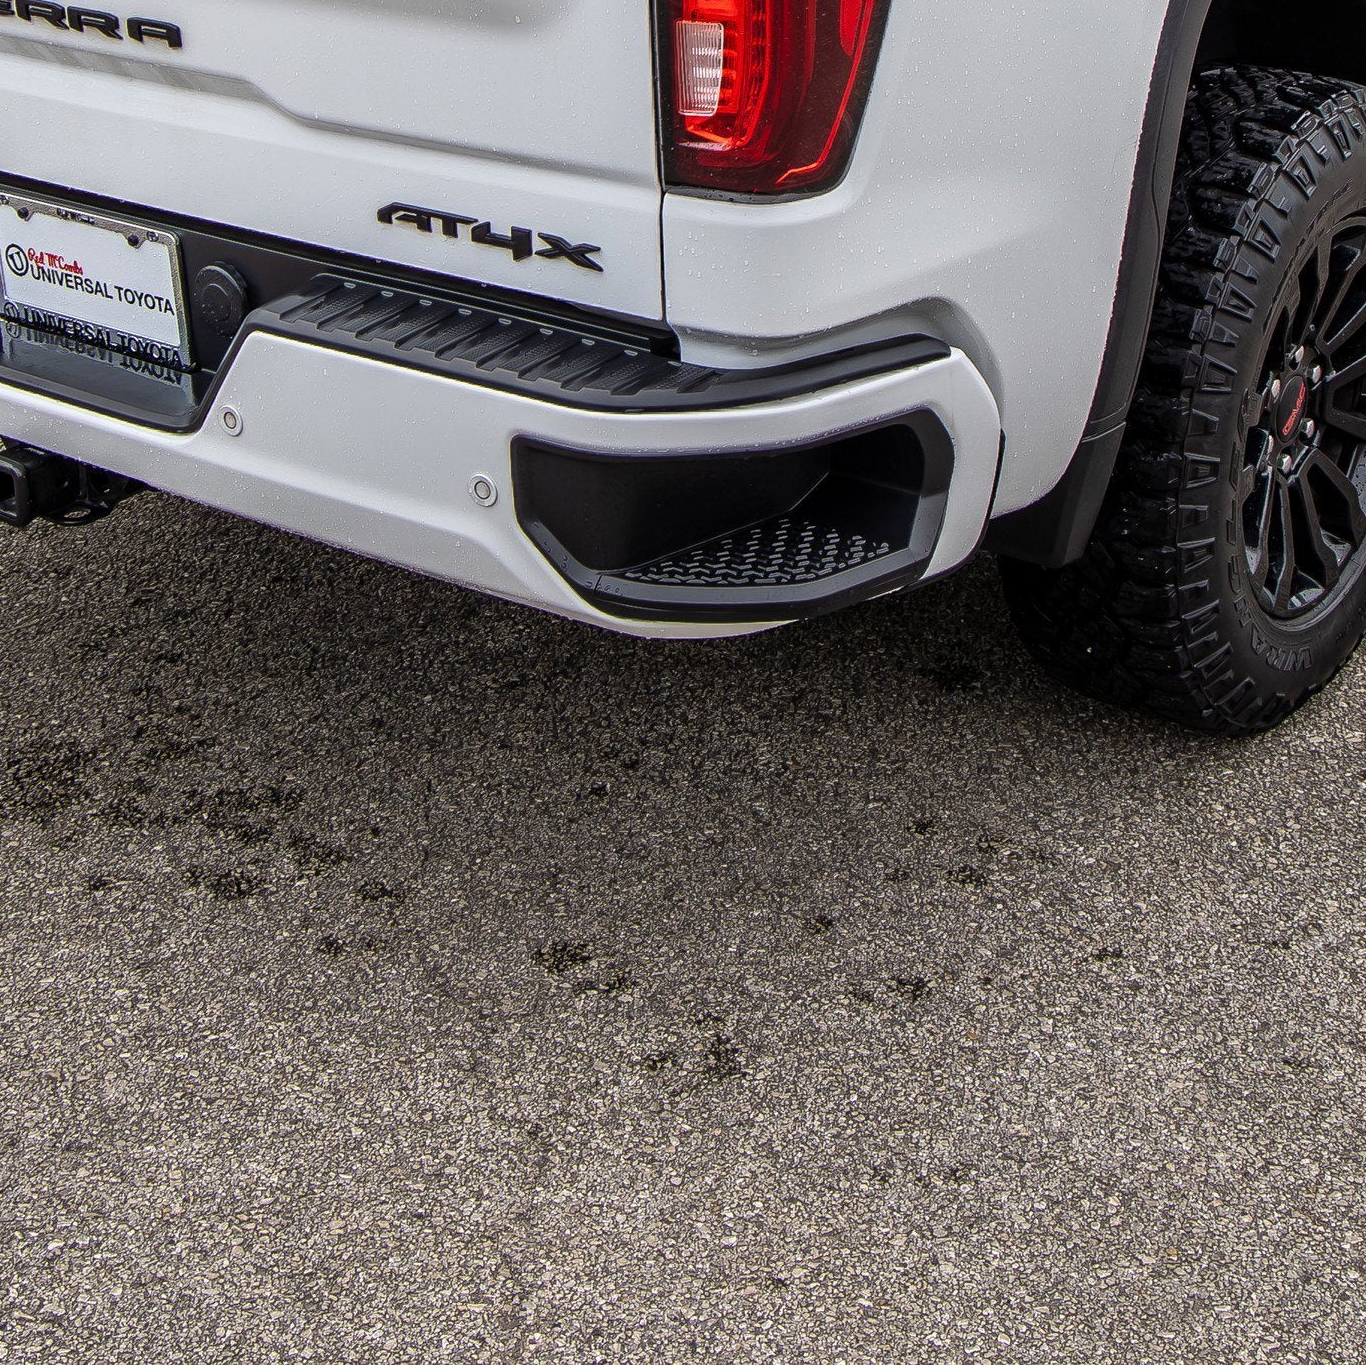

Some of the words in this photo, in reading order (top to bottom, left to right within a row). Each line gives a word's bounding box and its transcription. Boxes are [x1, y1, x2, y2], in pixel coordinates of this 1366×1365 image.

[27, 247, 46, 267] Red
[377, 201, 604, 272] AT4X
[29, 264, 114, 300] UNIVERSAL
[113, 285, 176, 317] TOYOTA
[116, 333, 184, 368] TOYOTA
